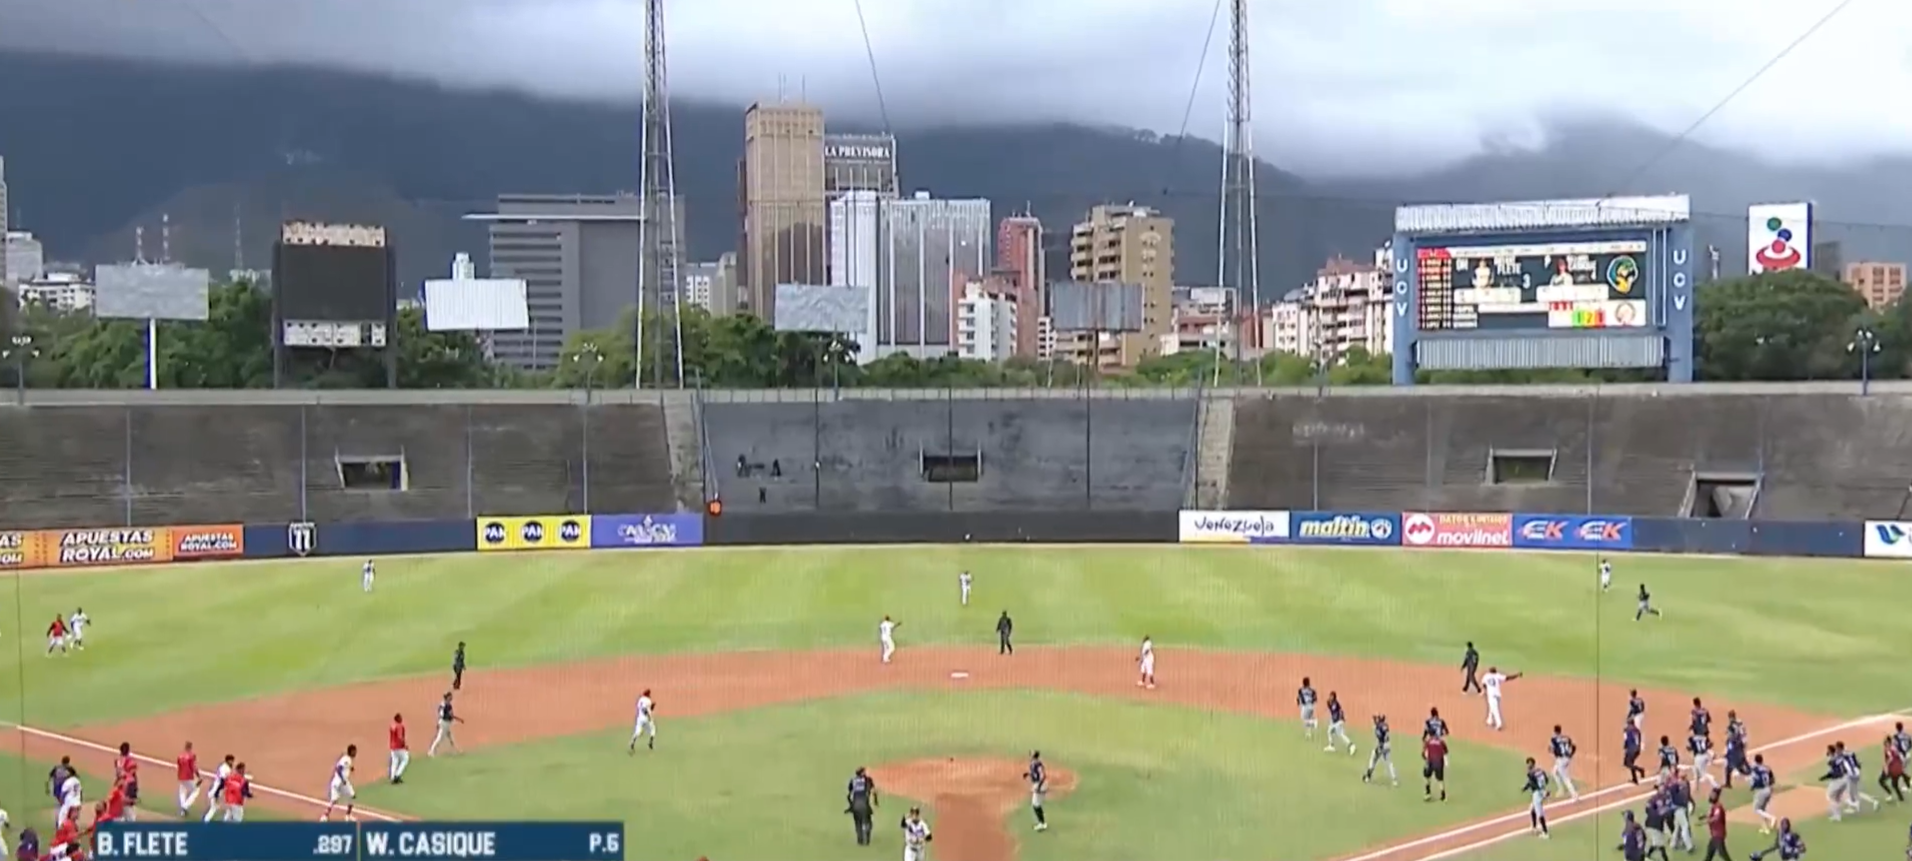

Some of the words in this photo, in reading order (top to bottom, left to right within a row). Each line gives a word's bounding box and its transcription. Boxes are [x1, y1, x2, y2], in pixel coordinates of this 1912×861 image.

[825, 146, 836, 156] LA
[63, 530, 153, 545] APUESTAS
[1437, 529, 1508, 544] movilnet
